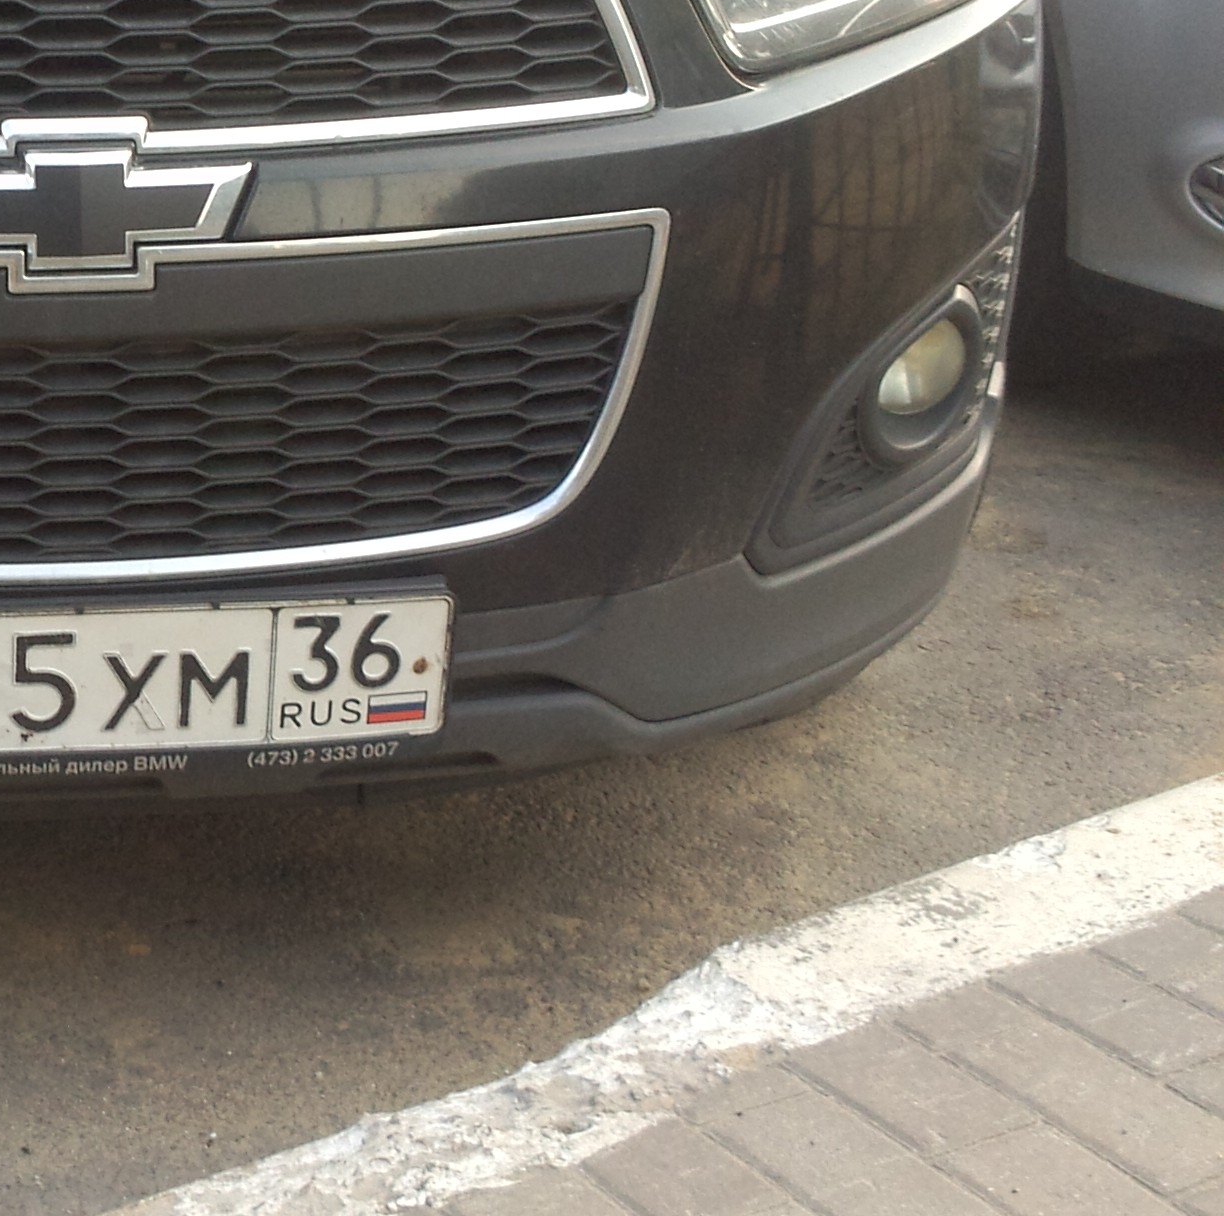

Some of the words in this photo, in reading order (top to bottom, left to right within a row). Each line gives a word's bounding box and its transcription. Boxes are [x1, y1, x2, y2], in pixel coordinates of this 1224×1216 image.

[293, 612, 401, 693] 36
[279, 698, 362, 729] RUS
[64, 758, 128, 775] дилер
[133, 754, 189, 772] BMW
[247, 748, 299, 769] (473)
[303, 748, 316, 764] 2
[320, 745, 359, 763] 333
[362, 740, 399, 759] 007
